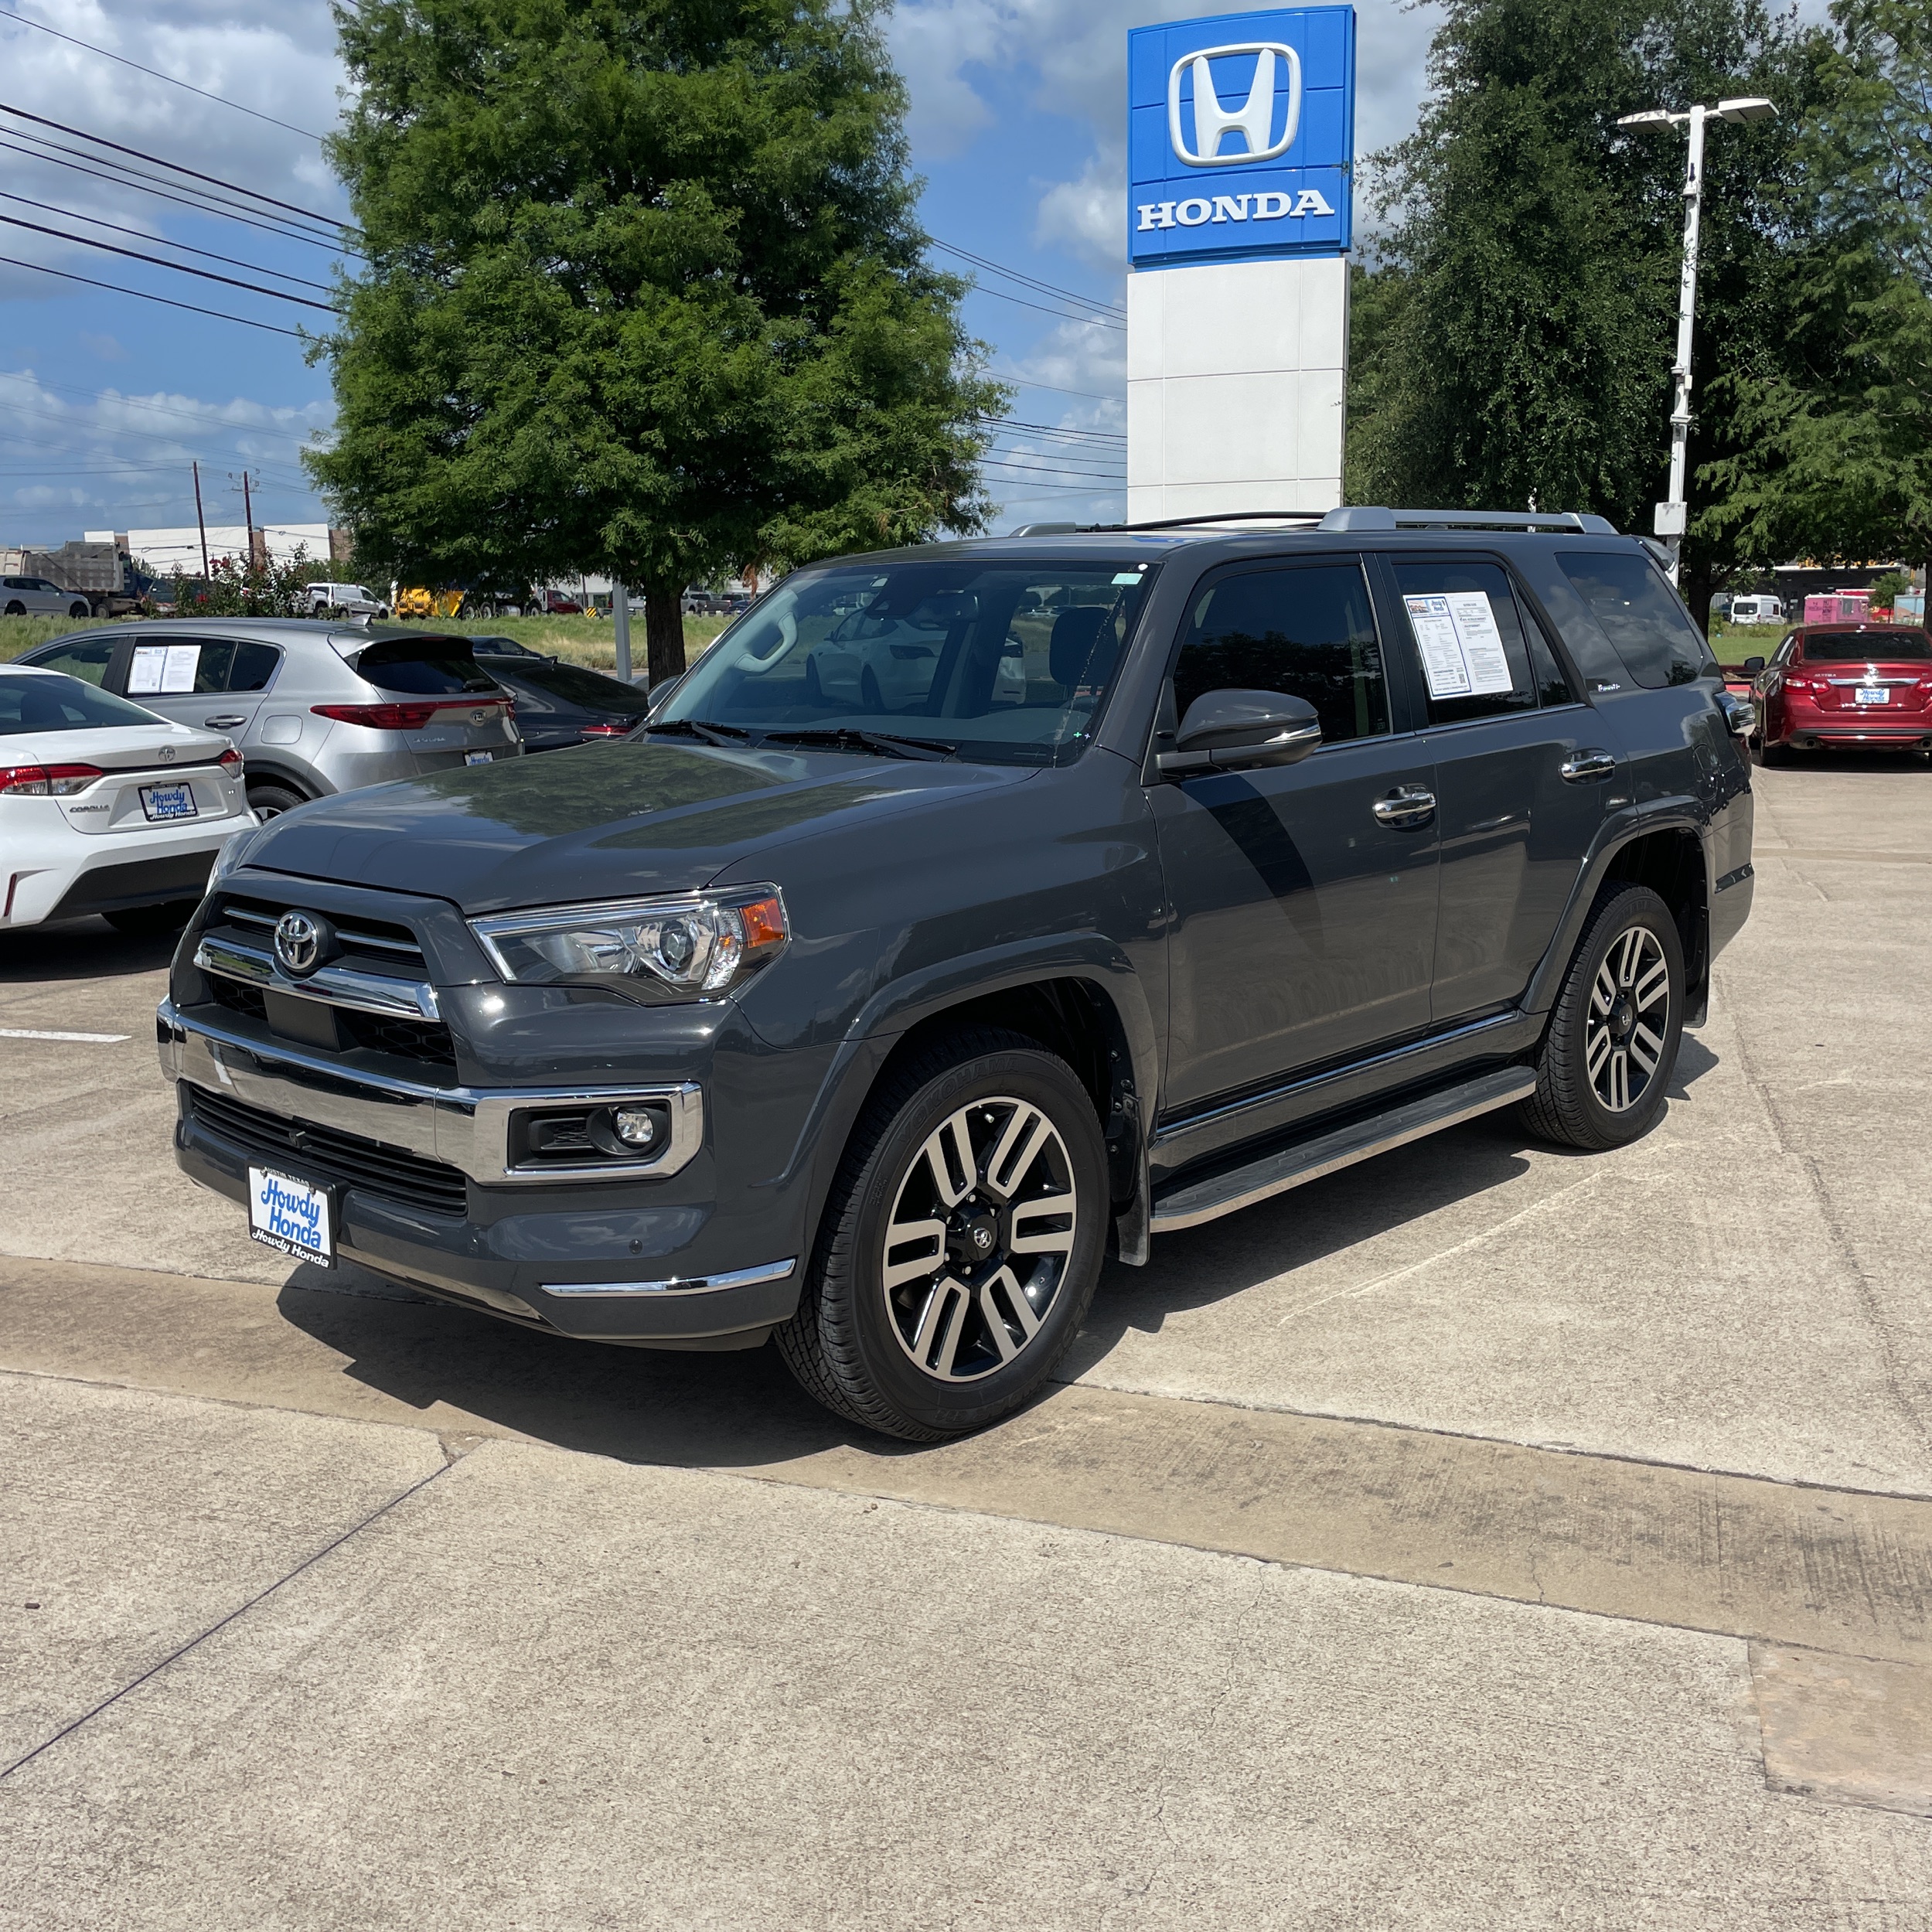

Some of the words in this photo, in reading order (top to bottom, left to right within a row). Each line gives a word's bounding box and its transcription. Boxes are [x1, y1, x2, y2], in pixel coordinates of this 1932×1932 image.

[1137, 189, 1335, 231] HONDA
[149, 789, 185, 804] Howdy
[157, 802, 188, 815] Honda
[288, 1174, 310, 1186] TEXAS
[261, 1178, 320, 1228] Howdy
[251, 1228, 291, 1254] Howdy
[291, 1243, 329, 1269] Honda
[268, 1206, 322, 1250] Honda
